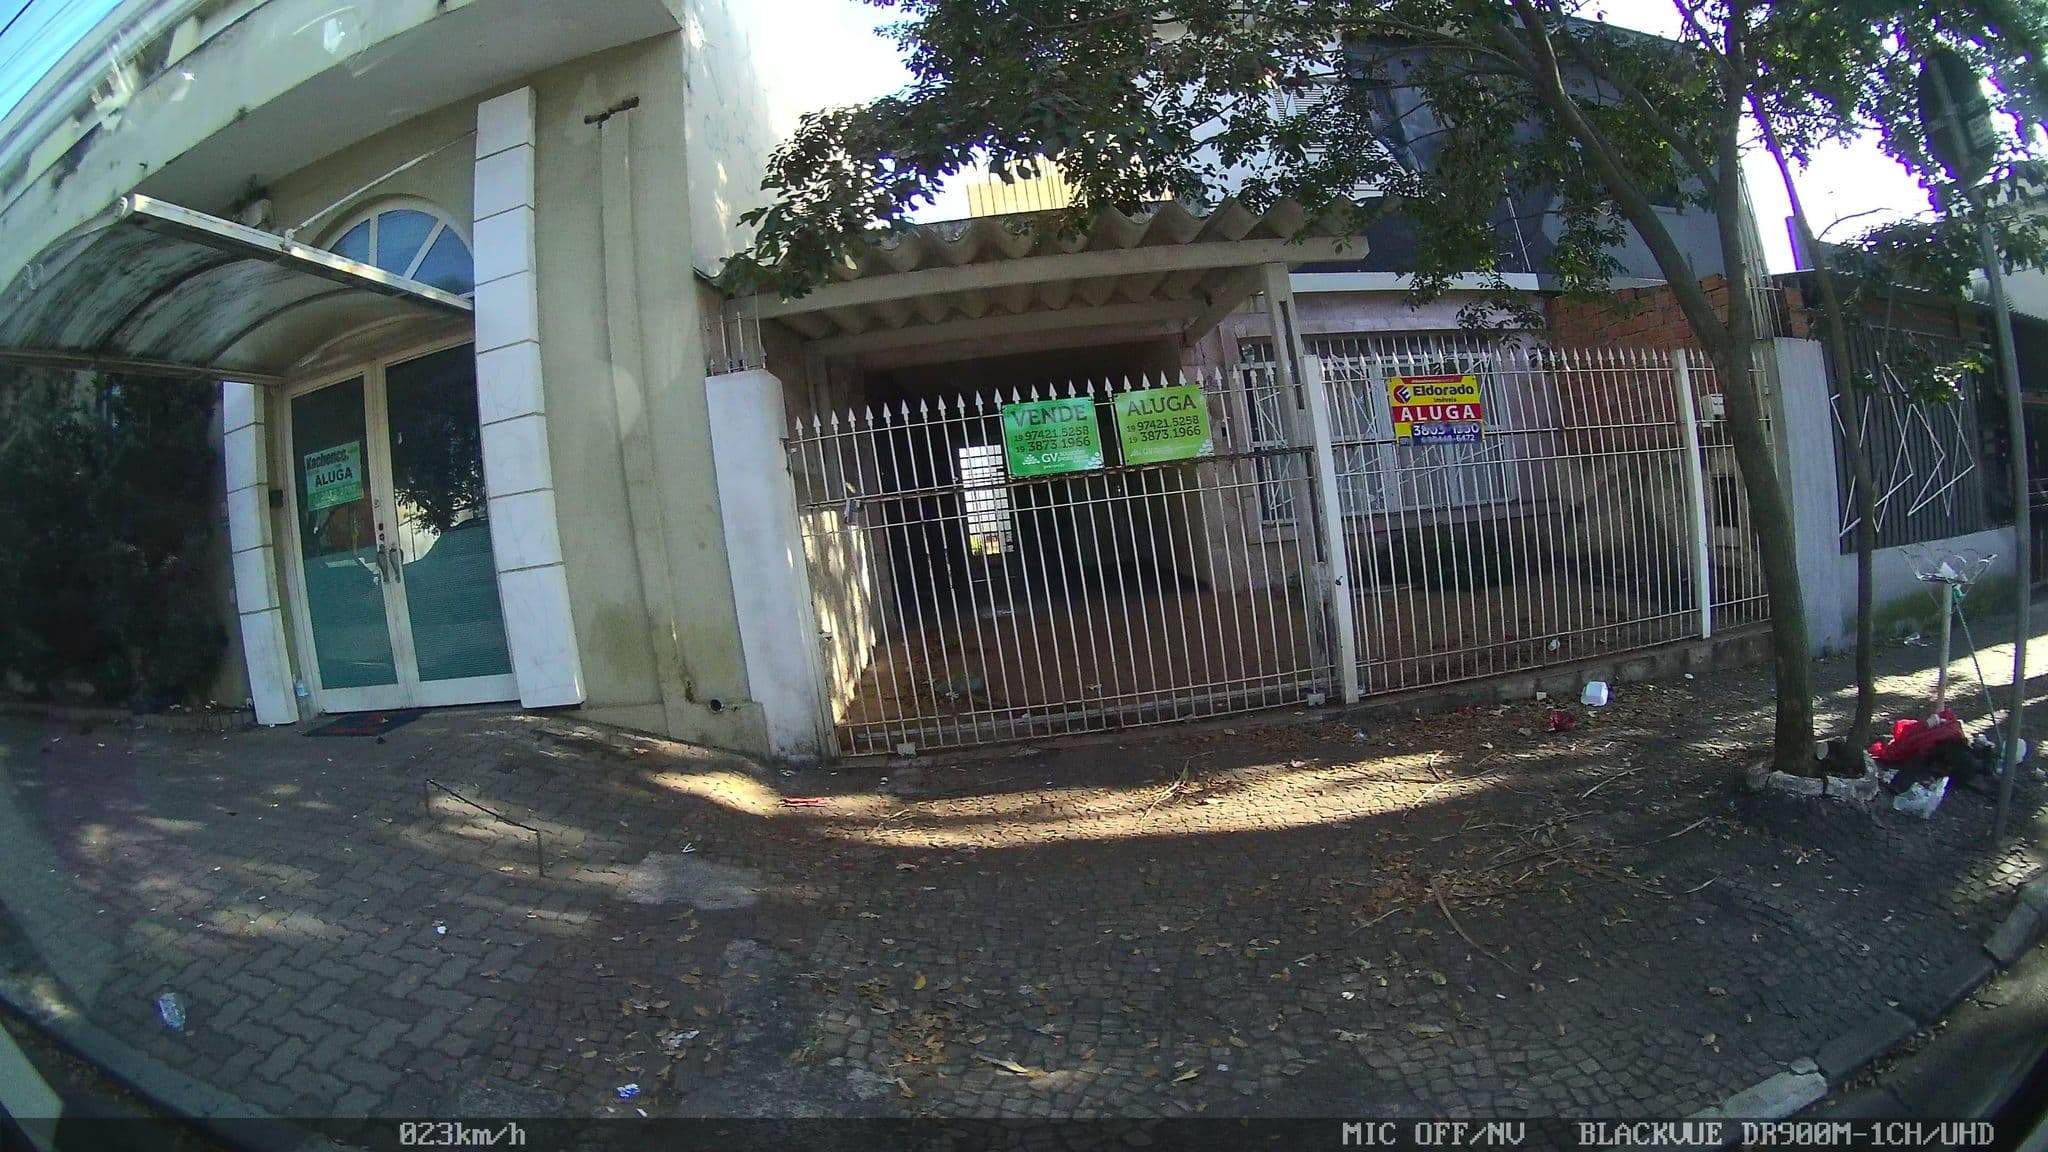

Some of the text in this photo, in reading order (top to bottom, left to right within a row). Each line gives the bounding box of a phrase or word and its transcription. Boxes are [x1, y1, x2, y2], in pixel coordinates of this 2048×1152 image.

[1413, 384, 1474, 396] Eldorado
[1127, 394, 1197, 416] ALUGA
[1400, 405, 1476, 421] ALUGA
[1010, 404, 1088, 428] VENDE
[1126, 415, 1200, 432] 19 97421.5258
[1140, 425, 1202, 442] 3873.1966
[1041, 452, 1059, 463] GV
[315, 467, 353, 488] ALUGA
